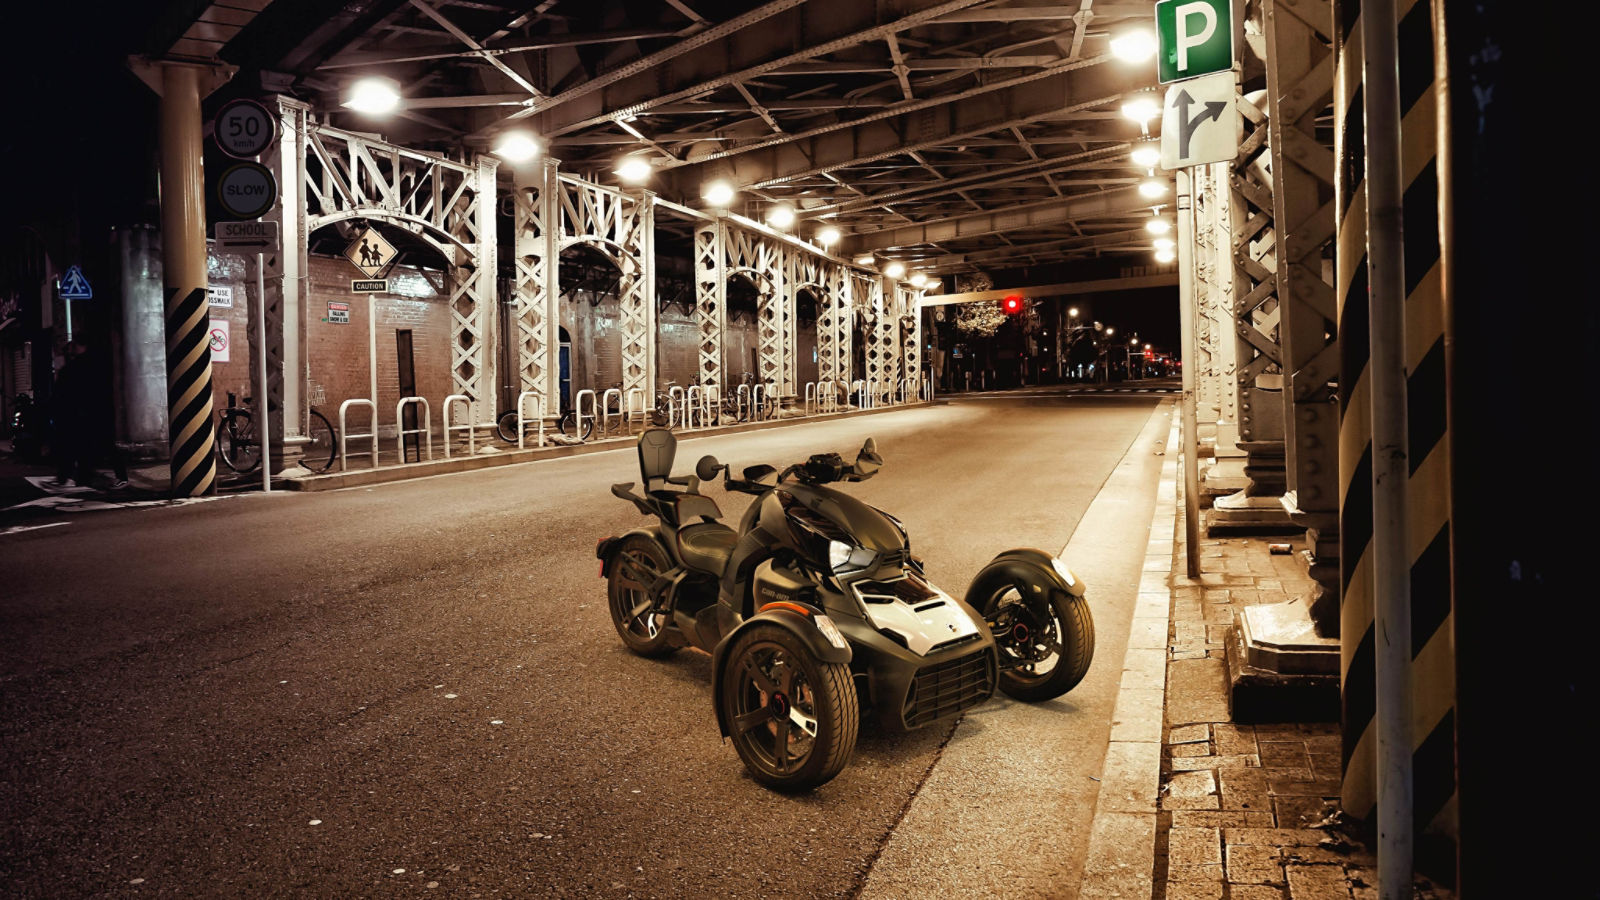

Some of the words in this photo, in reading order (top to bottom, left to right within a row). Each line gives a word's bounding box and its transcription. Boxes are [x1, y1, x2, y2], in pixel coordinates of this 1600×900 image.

[1175, 1, 1218, 72] P
[229, 117, 259, 137] 50
[233, 139, 255, 148] km/h
[227, 185, 264, 196] SLOW
[226, 224, 267, 236] SCHOOL
[217, 289, 229, 297] USE
